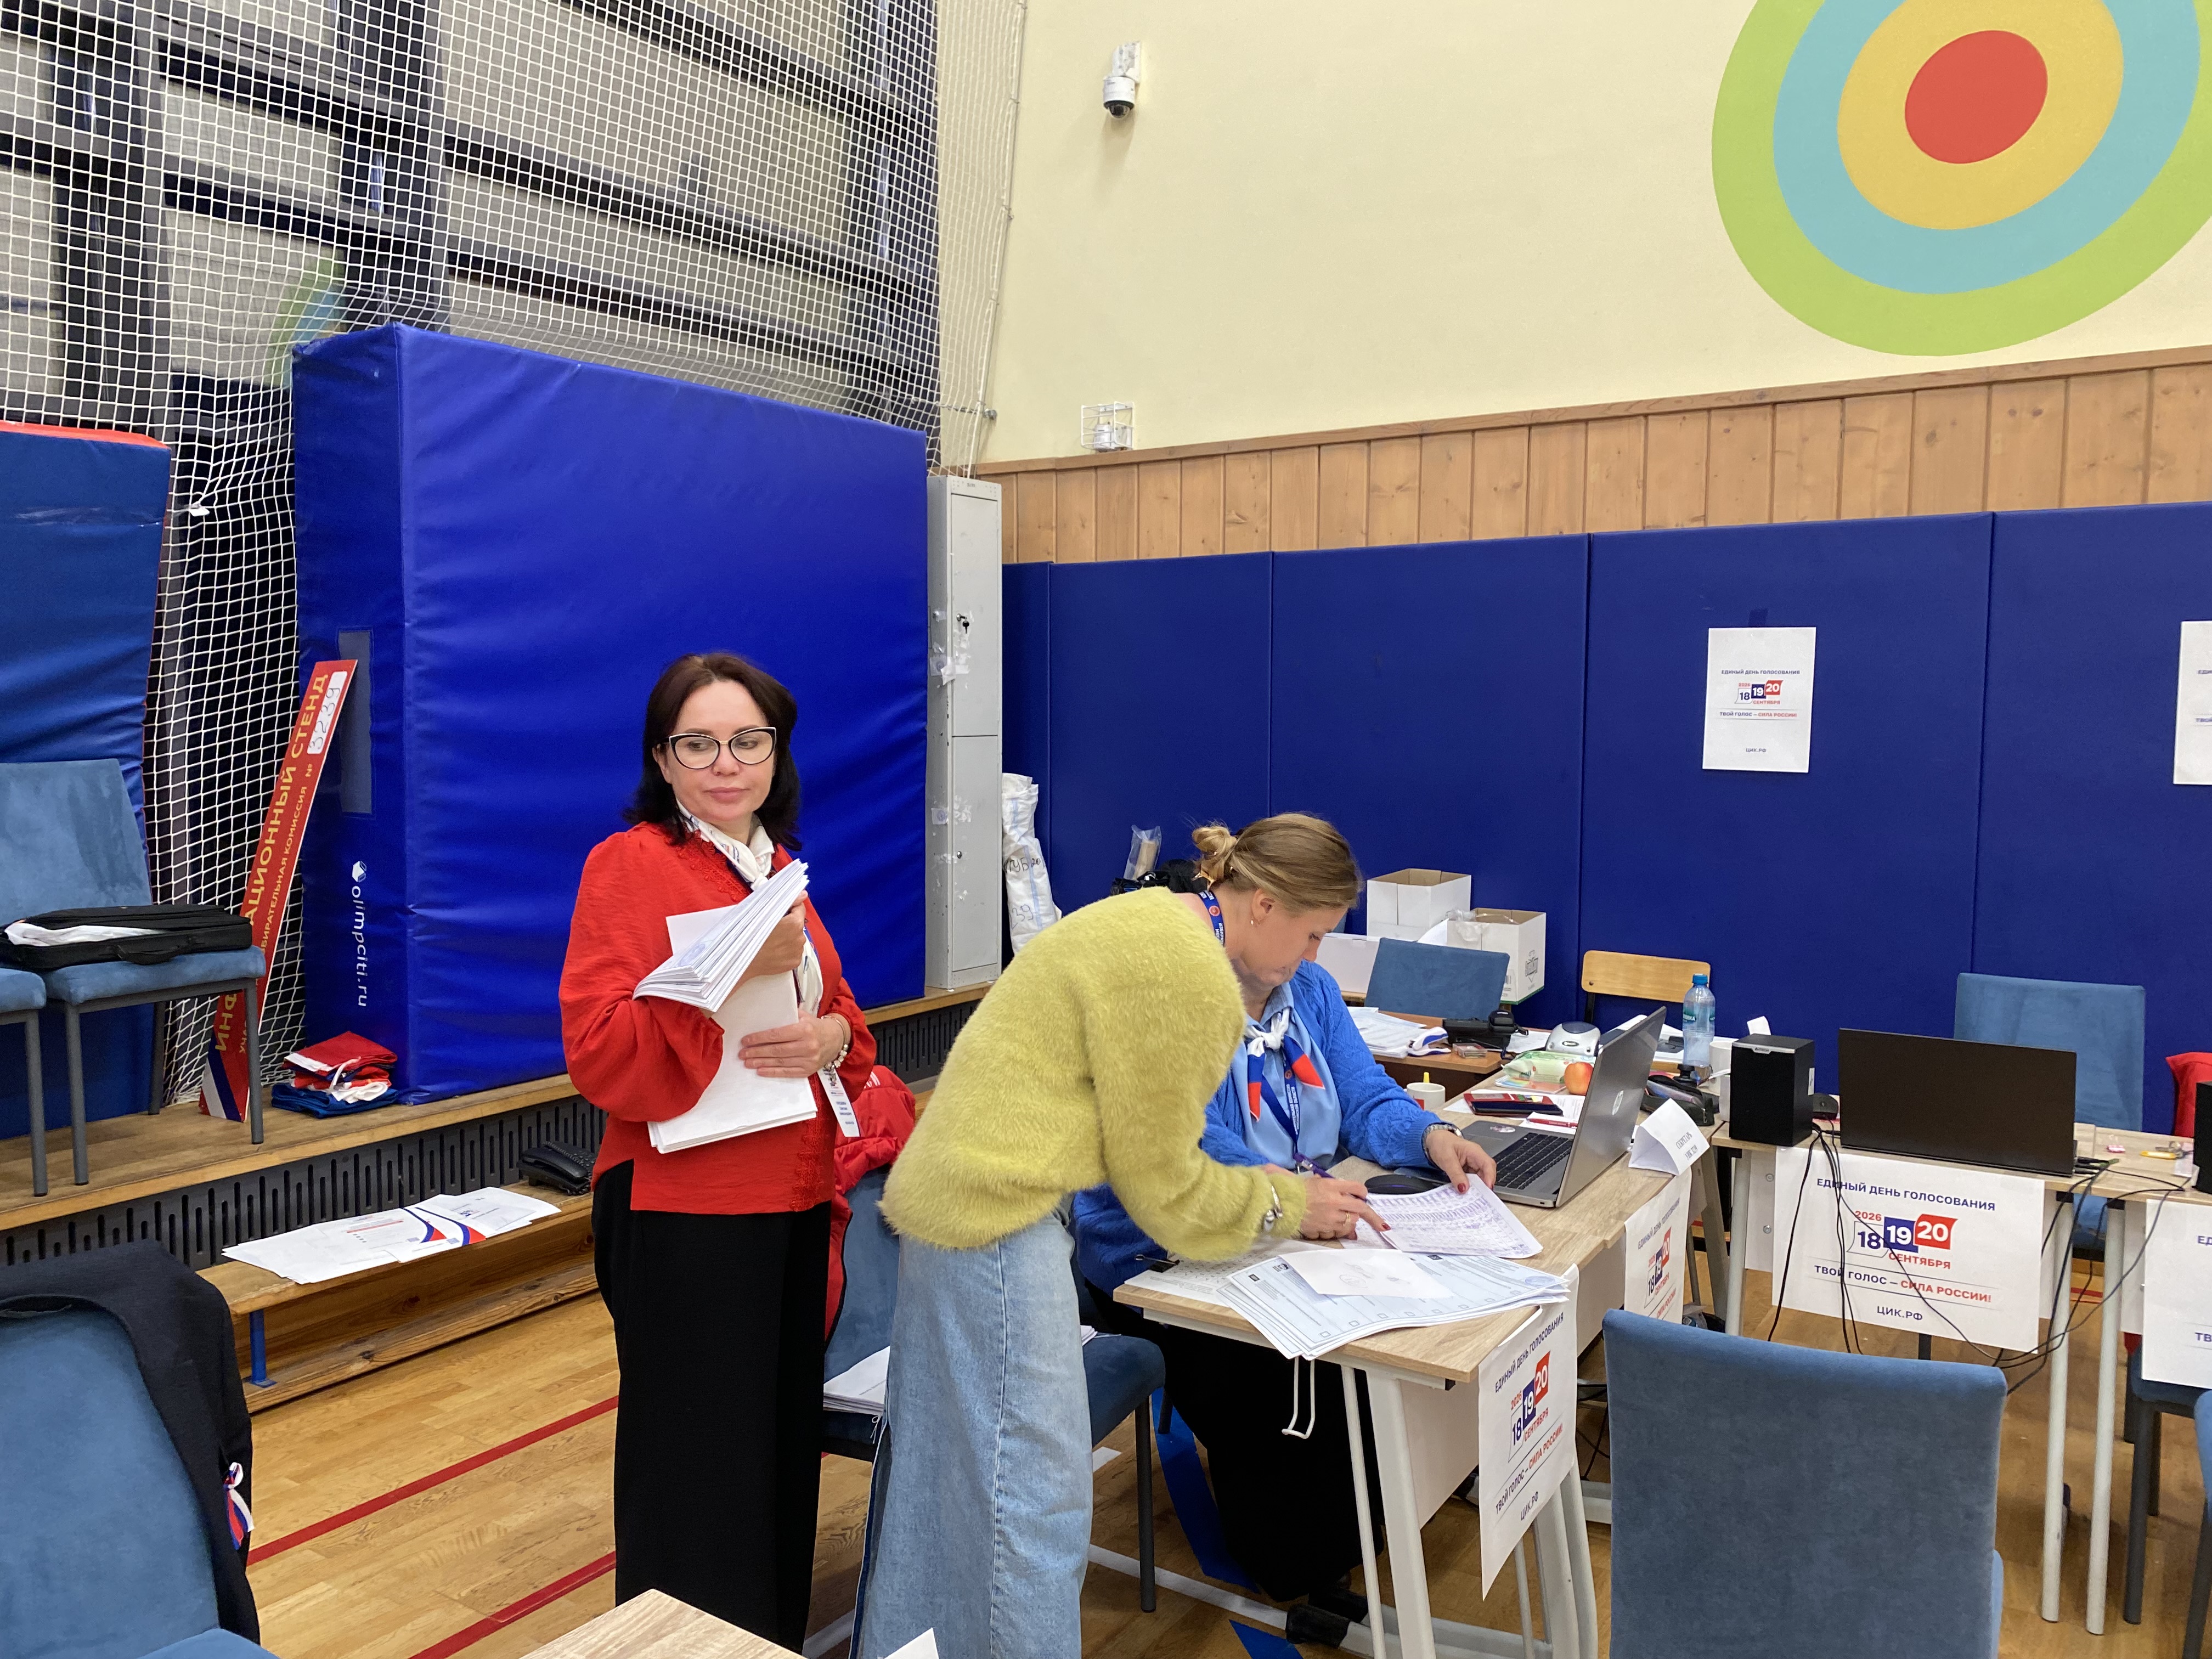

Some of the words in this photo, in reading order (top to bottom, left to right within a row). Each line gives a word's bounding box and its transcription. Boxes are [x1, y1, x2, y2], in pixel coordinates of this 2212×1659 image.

[1740, 692, 1750, 701] 18
[1752, 687, 1764, 697] 19
[1765, 683, 1779, 692] 20
[291, 674, 329, 759] СТЕНД
[309, 687, 340, 750] 3239
[261, 857, 288, 956] БИРАТЕЛЬНАЯ
[284, 786, 307, 855] КОМИССИЯ
[304, 763, 313, 777] №
[351, 885, 368, 1007] olimpciti.ru
[1869, 1186, 1900, 1197] ДЕНЬ
[1904, 1190, 1995, 1211] ГОЛОСОВАНИЯ
[1855, 1210, 1882, 1221] 2026
[1858, 1231, 1881, 1250] 18
[1886, 1225, 1912, 1245] 19
[1917, 1221, 1949, 1242] 20
[1888, 1252, 1951, 1269] СЕНТЯБРЯ
[1648, 1274, 1655, 1296] 18
[1848, 1271, 1887, 1285] ГОЛОС
[1900, 1280, 1933, 1293] СИЛА
[1937, 1286, 1991, 1302] РОССИИ!
[1877, 1306, 1923, 1321] ЦИК.РФ
[1496, 1359, 1516, 1393] ЕДИНЫЙ
[1516, 1348, 1529, 1371] ДЕНЬ
[1530, 1312, 1564, 1355] ГОЛОСОВАНИЯ
[1511, 1390, 1522, 1411] 2026
[1512, 1417, 1522, 1446] 18
[1523, 1391, 1534, 1419] 19
[1535, 1364, 1548, 1395] 20
[1524, 1407, 1549, 1442] СЕНТЯБРЯ
[1496, 1489, 1508, 1515] ТВОЙ
[1509, 1469, 1525, 1497] ГОЛОС
[1529, 1448, 1543, 1470] СИЛА
[1543, 1423, 1563, 1451] РОССИИ!
[1520, 1491, 1539, 1521] ЦИК.РФ
